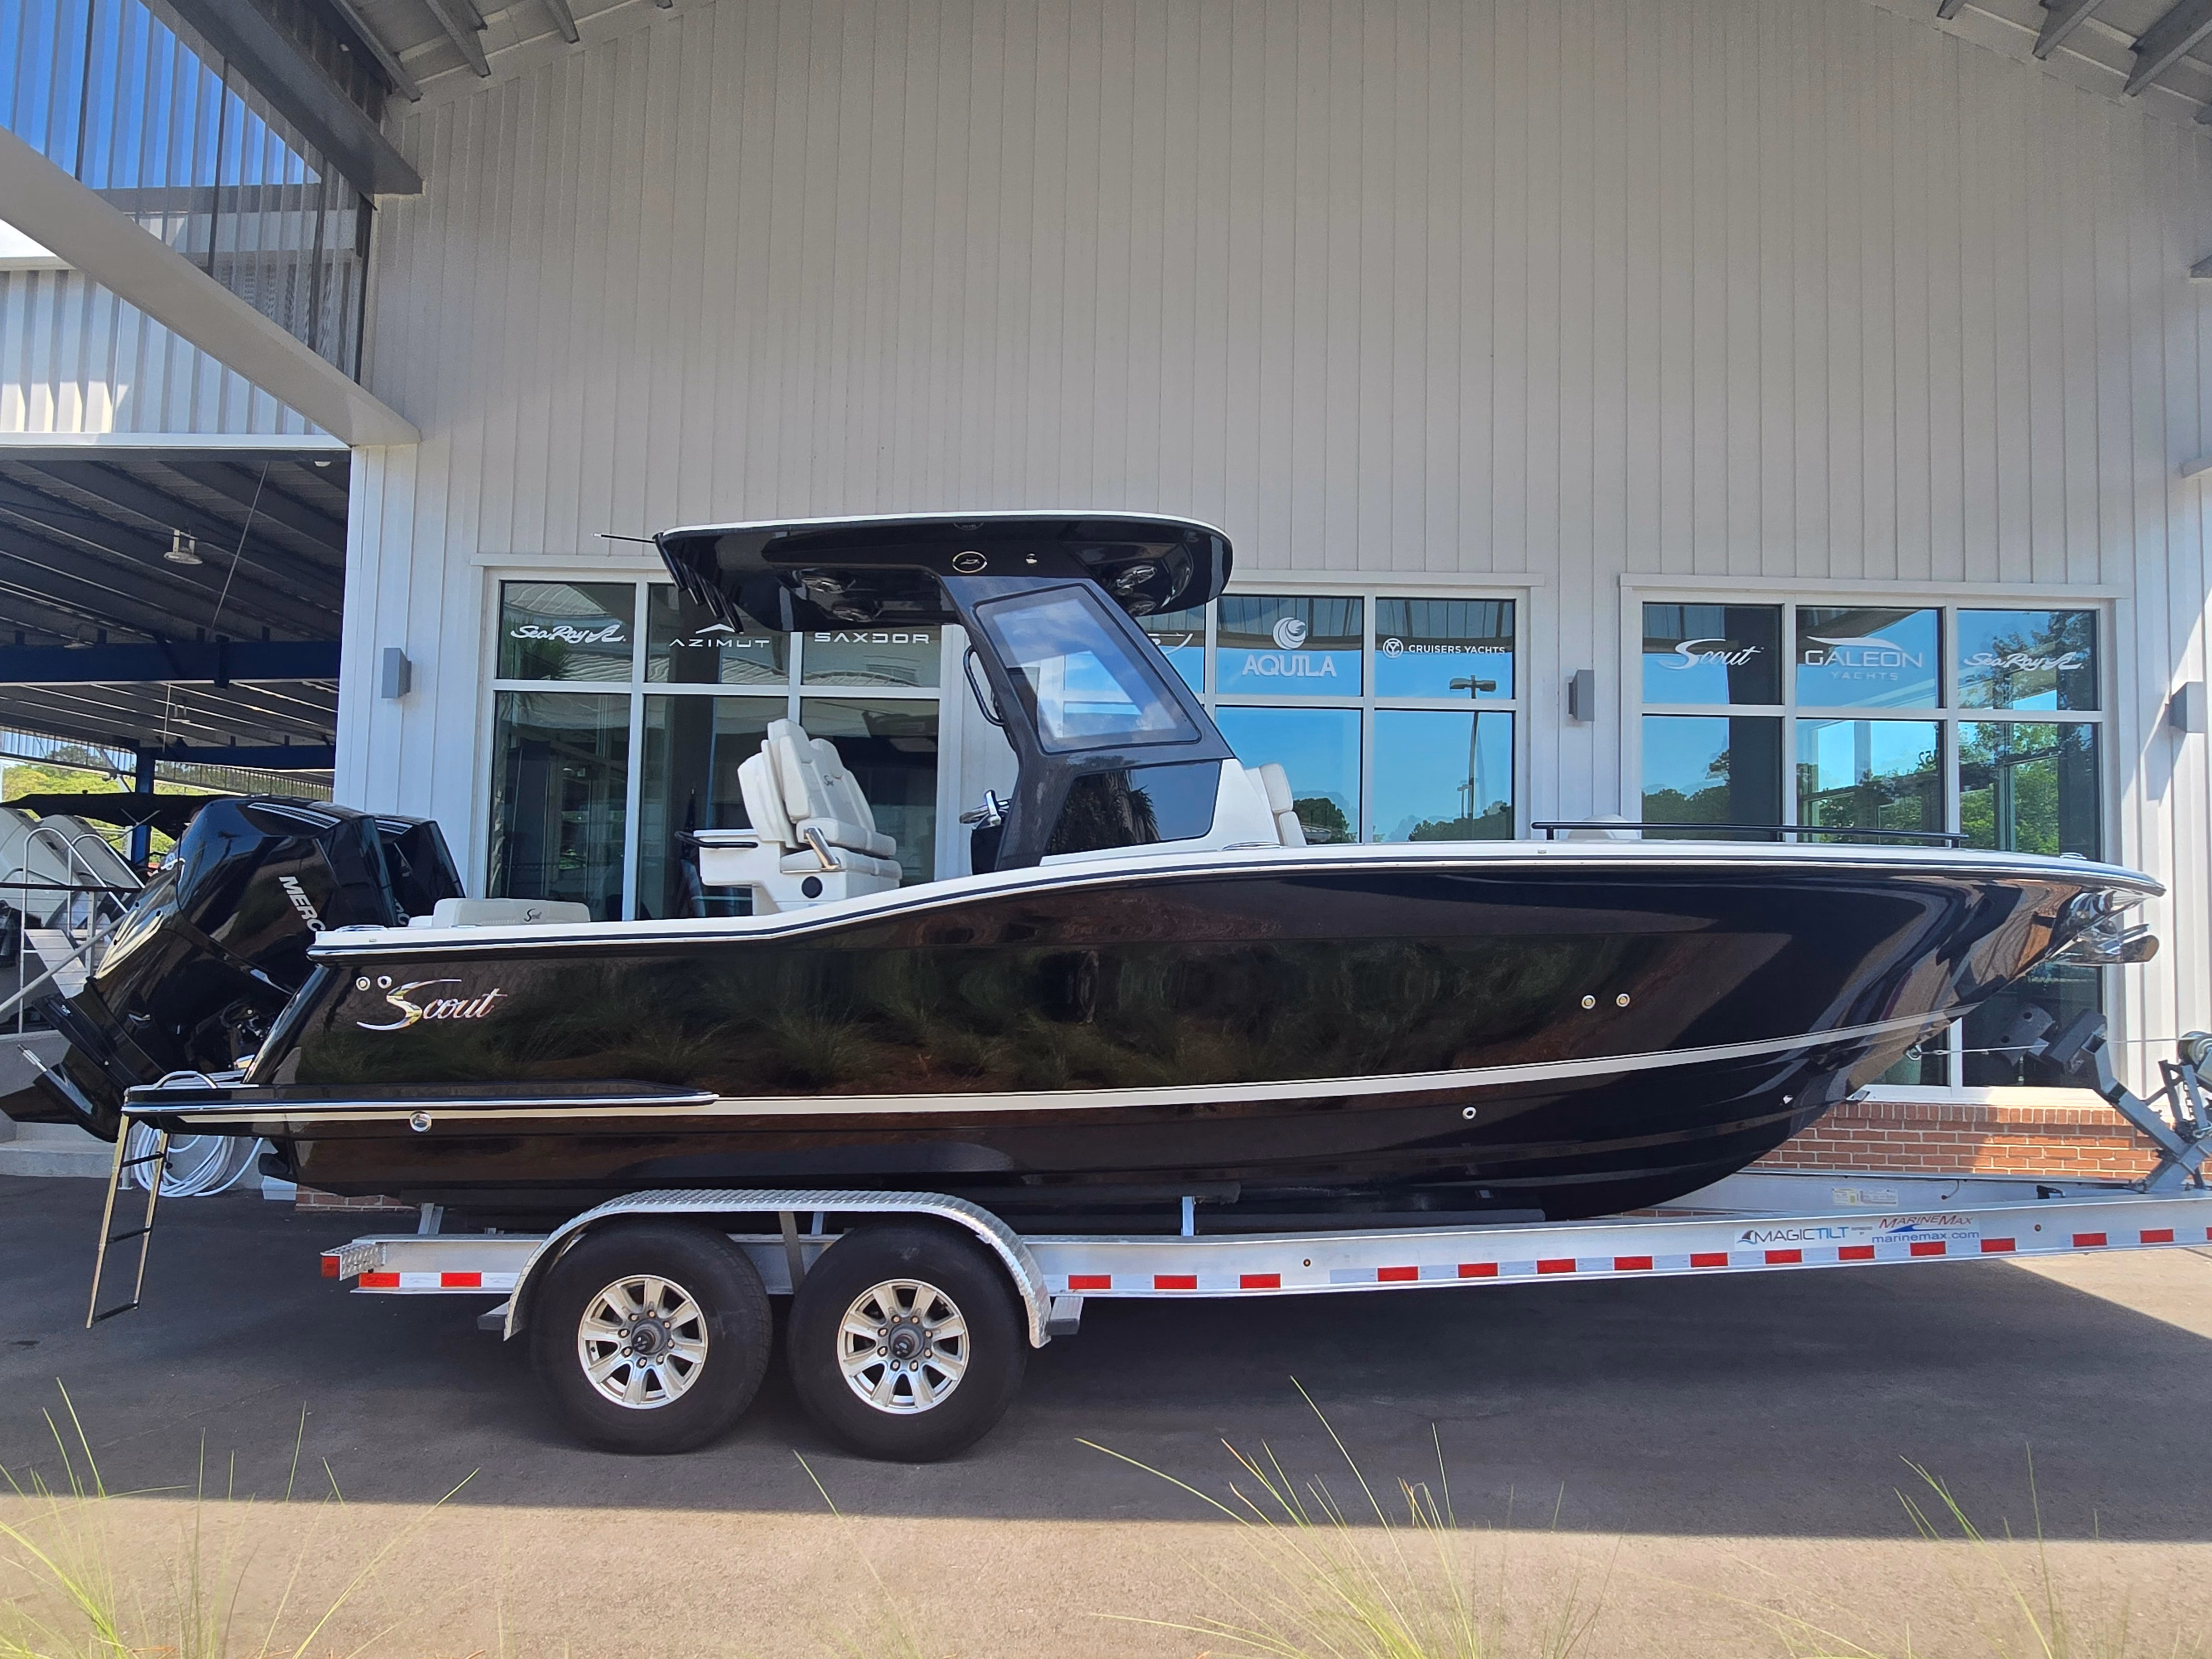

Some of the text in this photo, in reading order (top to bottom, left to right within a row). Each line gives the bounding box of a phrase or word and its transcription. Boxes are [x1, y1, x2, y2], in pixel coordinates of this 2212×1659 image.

[669, 638, 770, 647] AZIMUT
[814, 632, 930, 644] SAXDOR
[1408, 644, 1505, 655] CRUISERS YACHTS
[1657, 638, 1762, 669] Scout
[1242, 654, 1337, 677] AQUILA
[1805, 649, 1923, 668] GALEON
[1831, 671, 1899, 681] YACHTS
[357, 979, 508, 1031] Scout
[1755, 1226, 1850, 1243] MAGICTILT
[1872, 1231, 1979, 1244] marinemax.com
